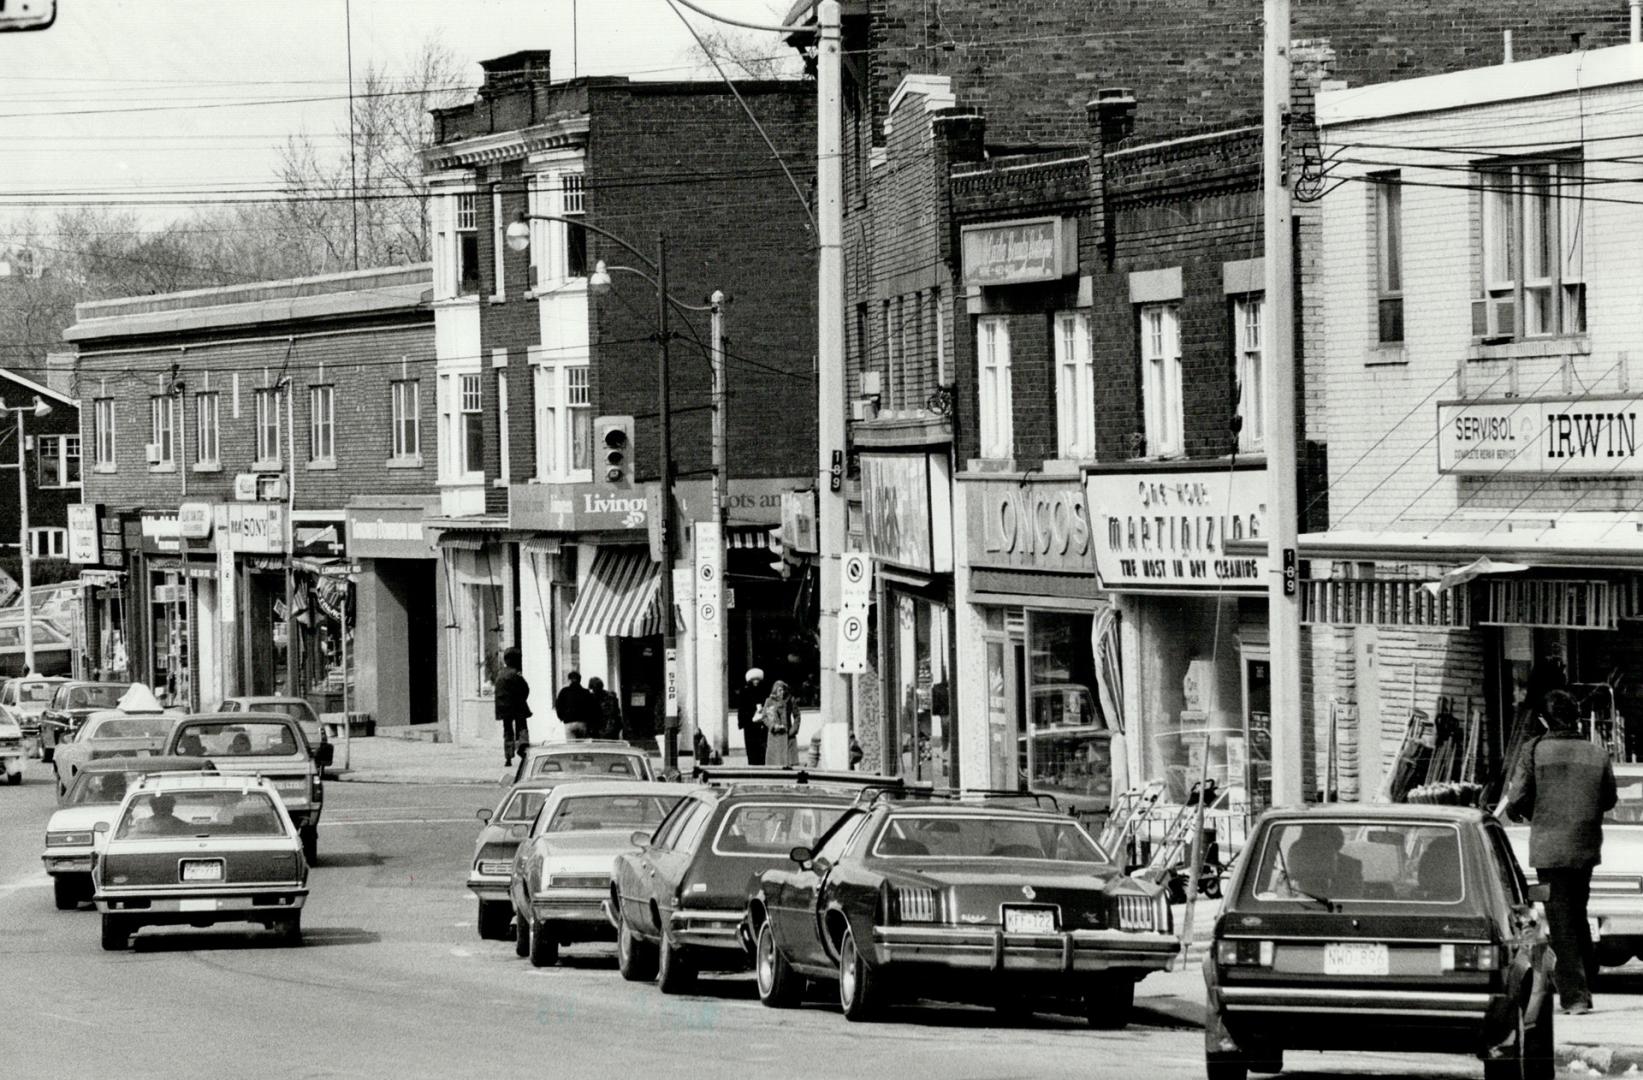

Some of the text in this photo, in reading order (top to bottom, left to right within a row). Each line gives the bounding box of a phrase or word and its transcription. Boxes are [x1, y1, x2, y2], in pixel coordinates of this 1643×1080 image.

[1456, 413, 1637, 457] SERVISOL IRWIN
[243, 518, 269, 537] SONY
[1120, 559, 1258, 579] THE MOST IN DRY CLEANING
[668, 672, 676, 700] STOP
